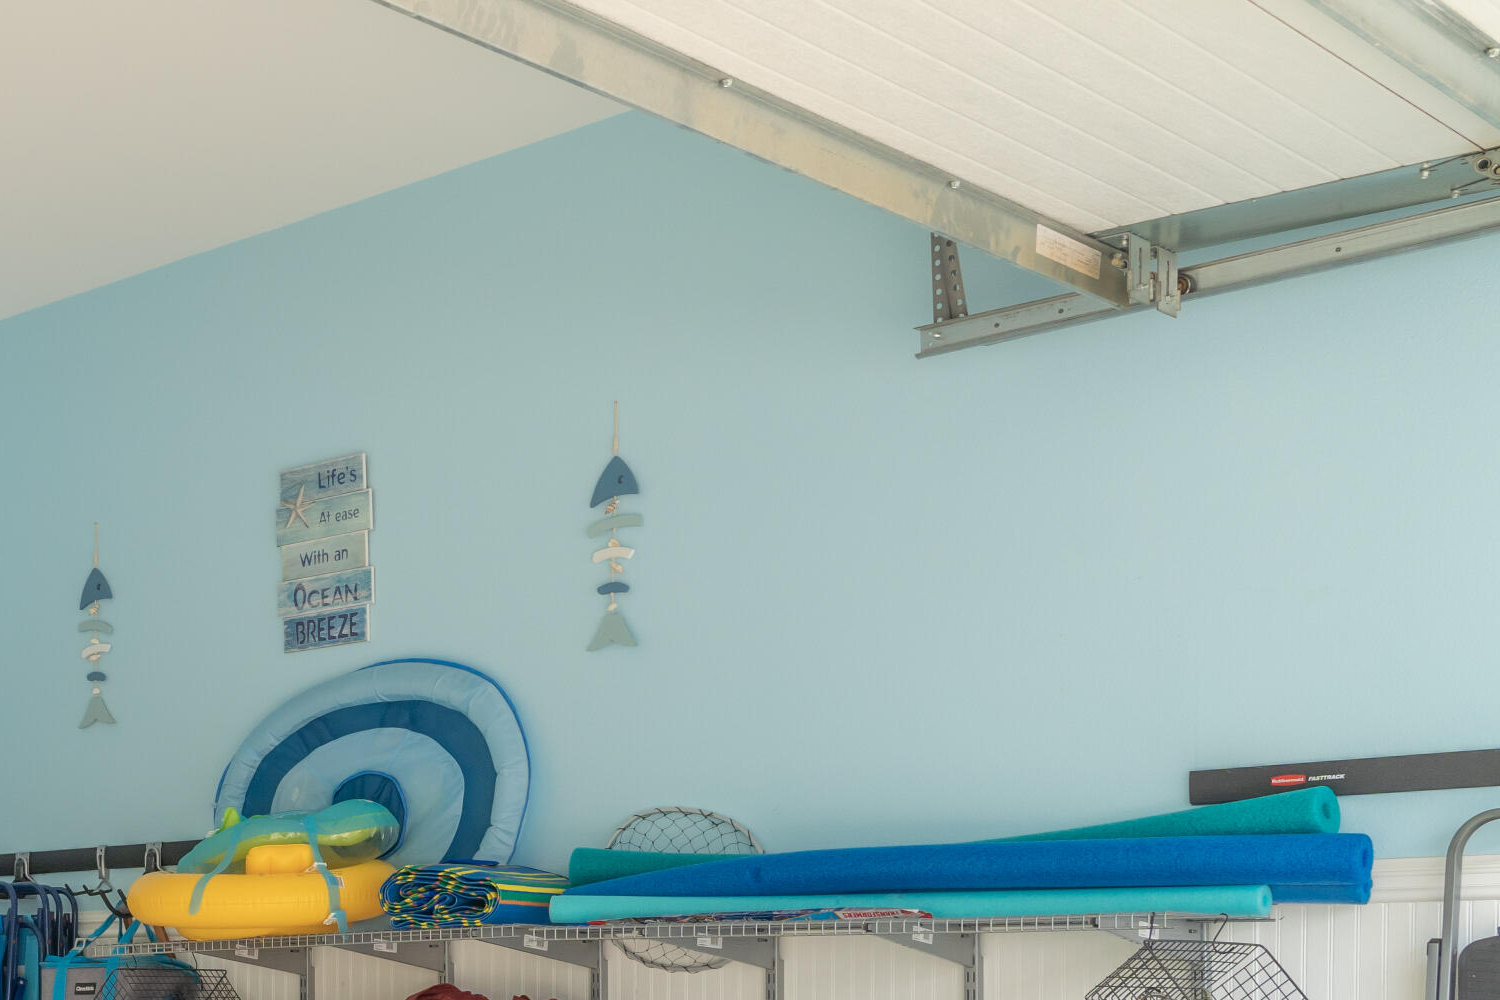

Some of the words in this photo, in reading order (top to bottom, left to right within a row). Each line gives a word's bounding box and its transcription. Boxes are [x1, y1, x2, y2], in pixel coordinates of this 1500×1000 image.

[318, 466, 357, 489] Life's
[319, 511, 331, 524] At
[335, 507, 360, 523] ease
[300, 549, 329, 568] With
[334, 548, 349, 562] an
[293, 582, 360, 611] OCEAN
[295, 611, 359, 645] BREEZE
